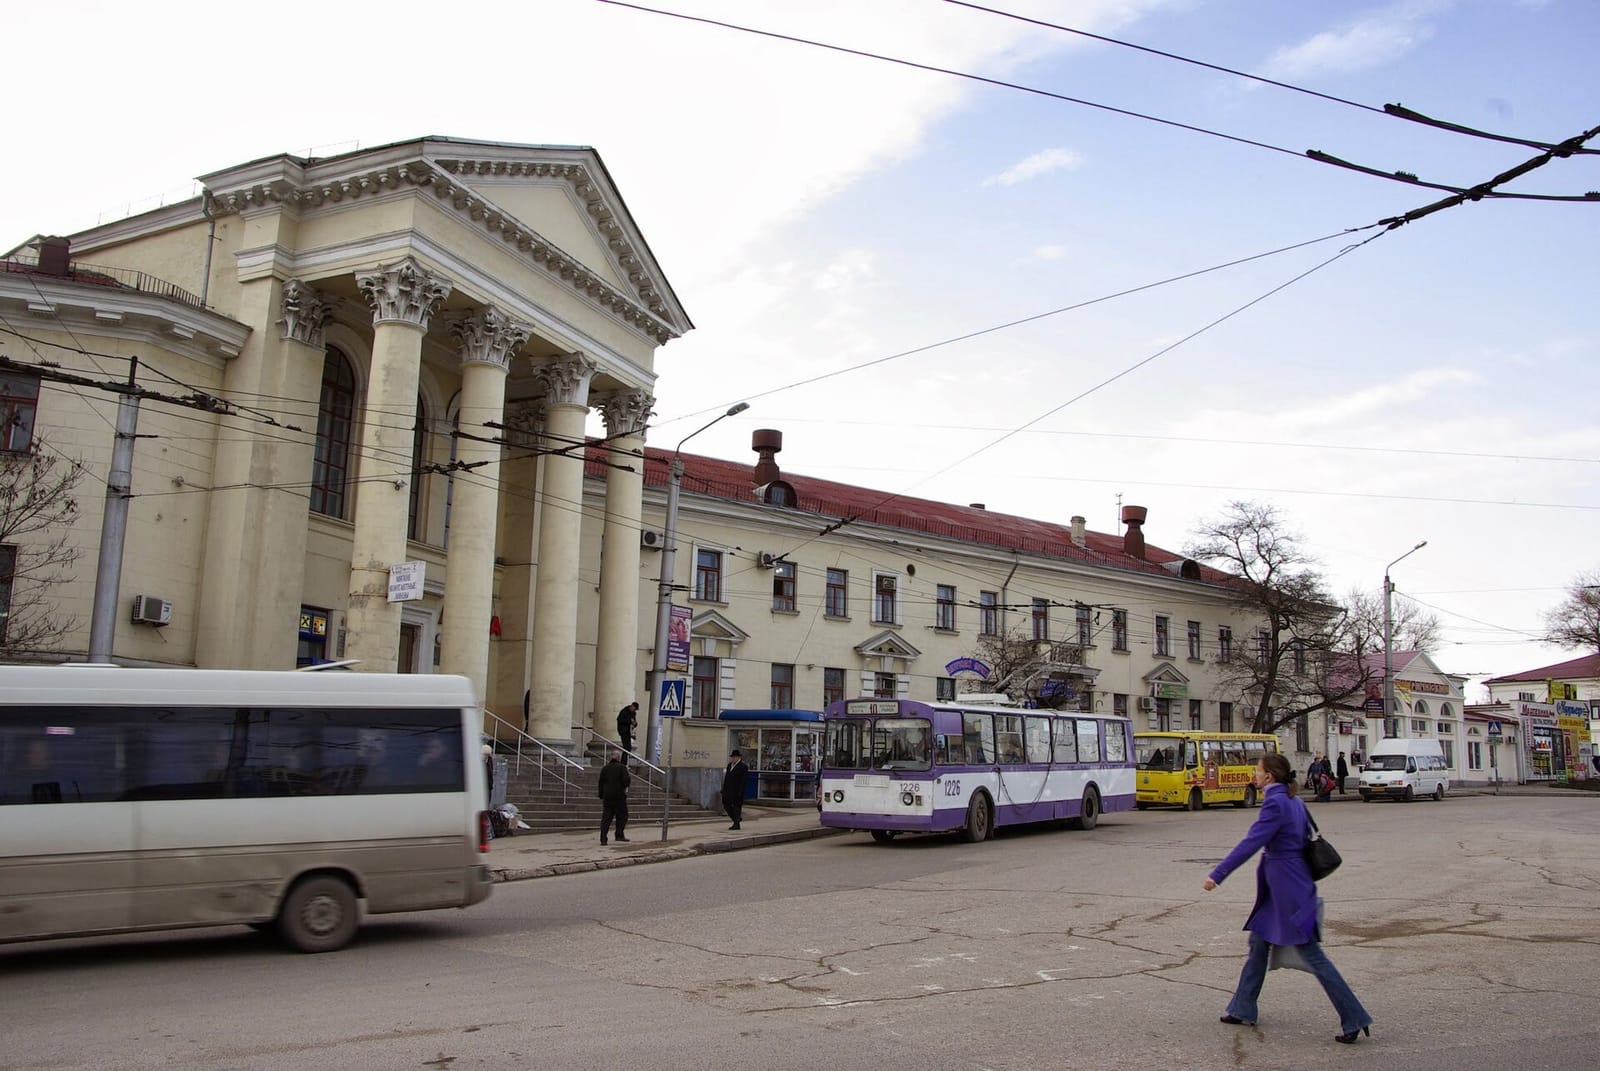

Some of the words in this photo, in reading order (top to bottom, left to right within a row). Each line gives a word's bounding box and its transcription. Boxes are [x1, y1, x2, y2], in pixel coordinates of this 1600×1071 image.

[1220, 772, 1250, 784] МЕБЕЛЬ
[899, 783, 920, 792] 1226
[944, 780, 961, 796] 1226
